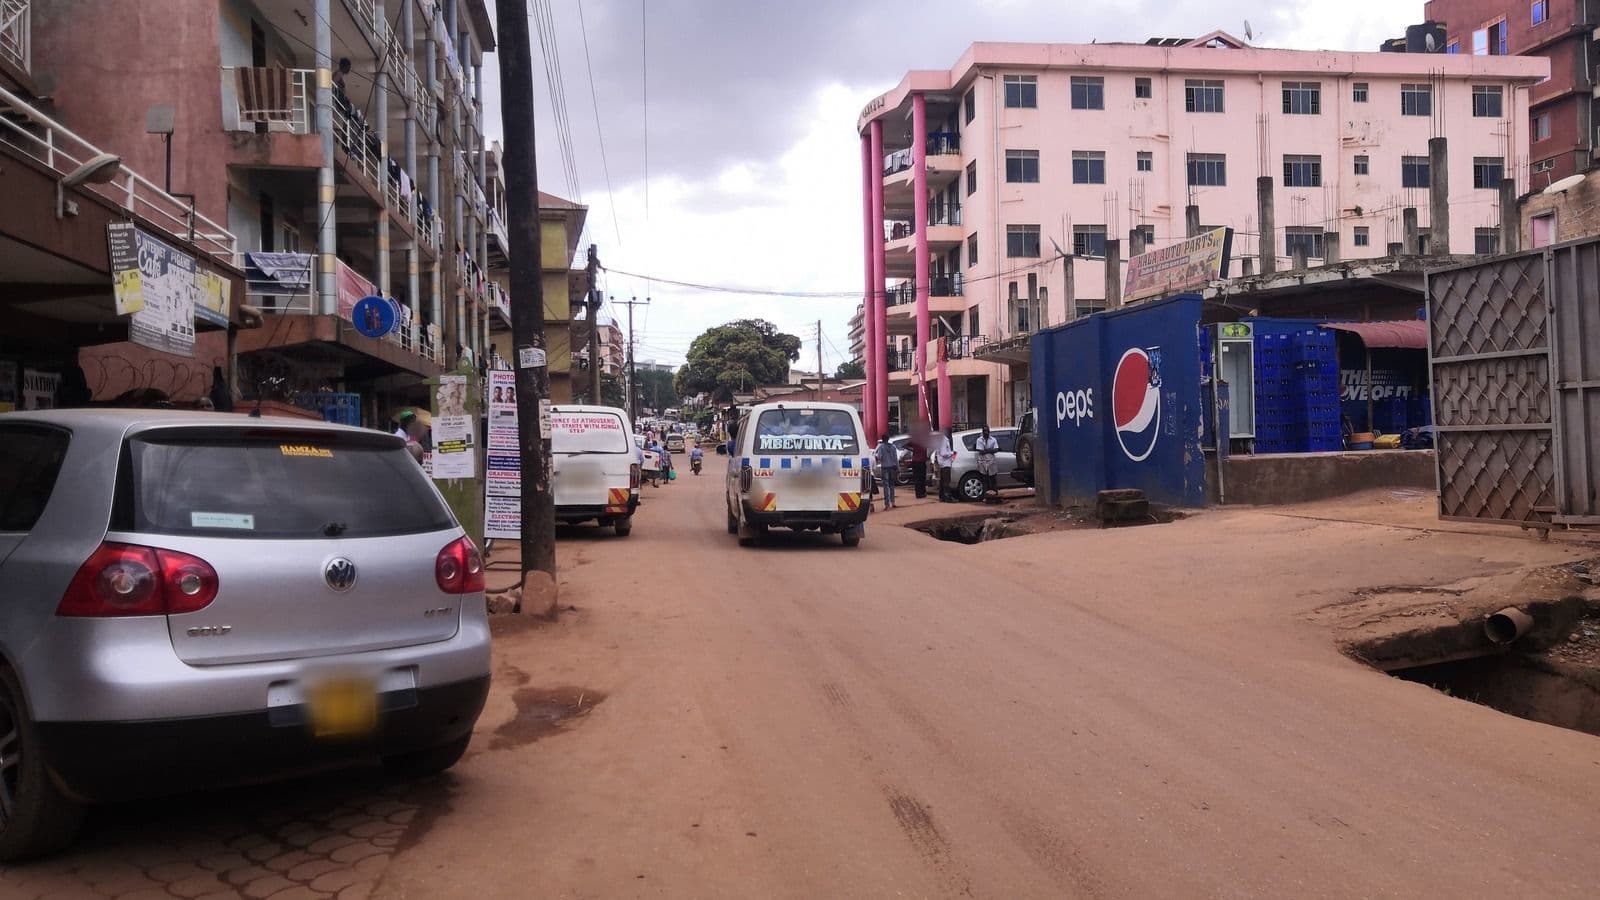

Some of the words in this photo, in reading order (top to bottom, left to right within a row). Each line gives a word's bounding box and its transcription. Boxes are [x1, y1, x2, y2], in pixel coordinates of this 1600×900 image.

[1160, 243, 1182, 262] AUTO
[1184, 233, 1214, 255] PARTS
[24, 375, 58, 392] STATION
[493, 373, 515, 381] PHOTO
[1340, 369, 1369, 385] THE
[1371, 385, 1394, 400] OF
[1395, 385, 1412, 400] IT
[760, 438, 844, 450] MBEWUNYA
[187, 625, 232, 638] GOLF
